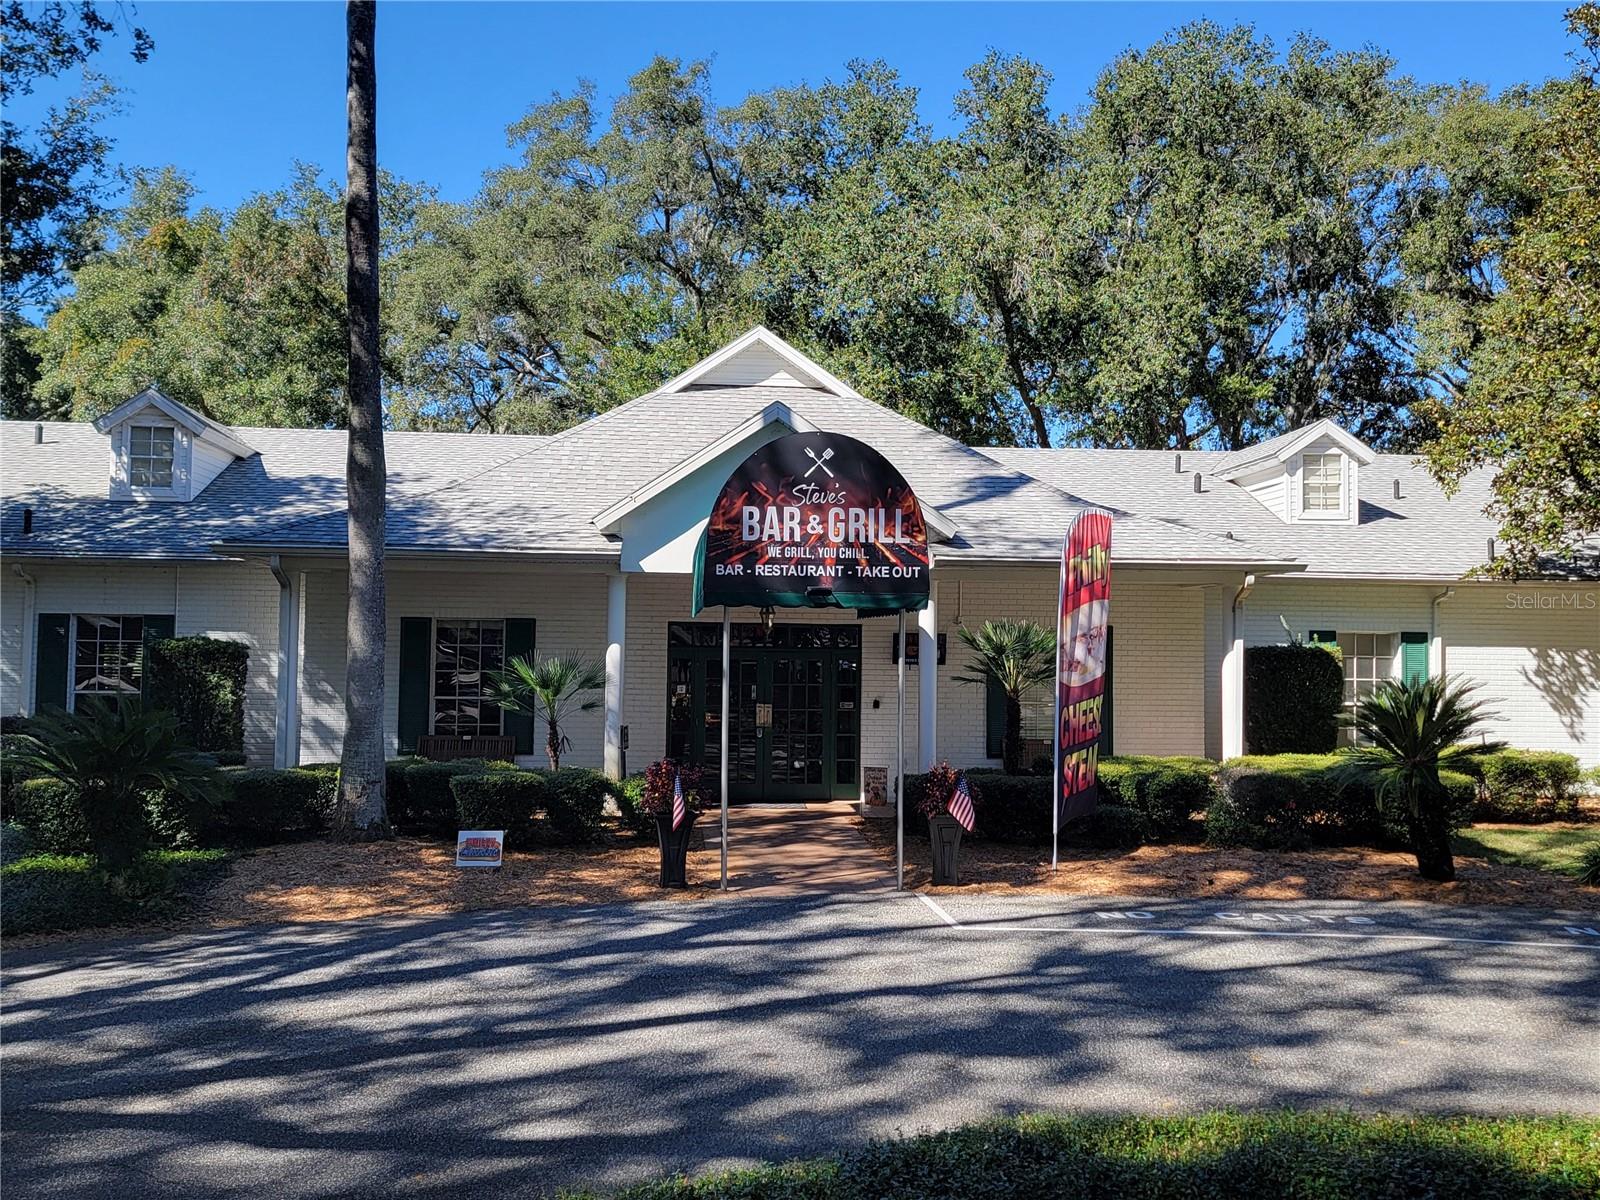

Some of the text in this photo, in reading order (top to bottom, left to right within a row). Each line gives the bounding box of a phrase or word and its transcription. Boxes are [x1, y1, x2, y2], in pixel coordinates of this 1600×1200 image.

[792, 482, 847, 507] Steve's
[742, 505, 911, 544] BAR & GRILL
[767, 546, 870, 559] WE GRILL, YOU CHILL.
[715, 563, 744, 576] BAR
[755, 564, 844, 577] RESTAURANT
[856, 566, 890, 578] TAKE
[892, 566, 921, 579] OUT
[1094, 911, 1376, 925] NO CARTS
